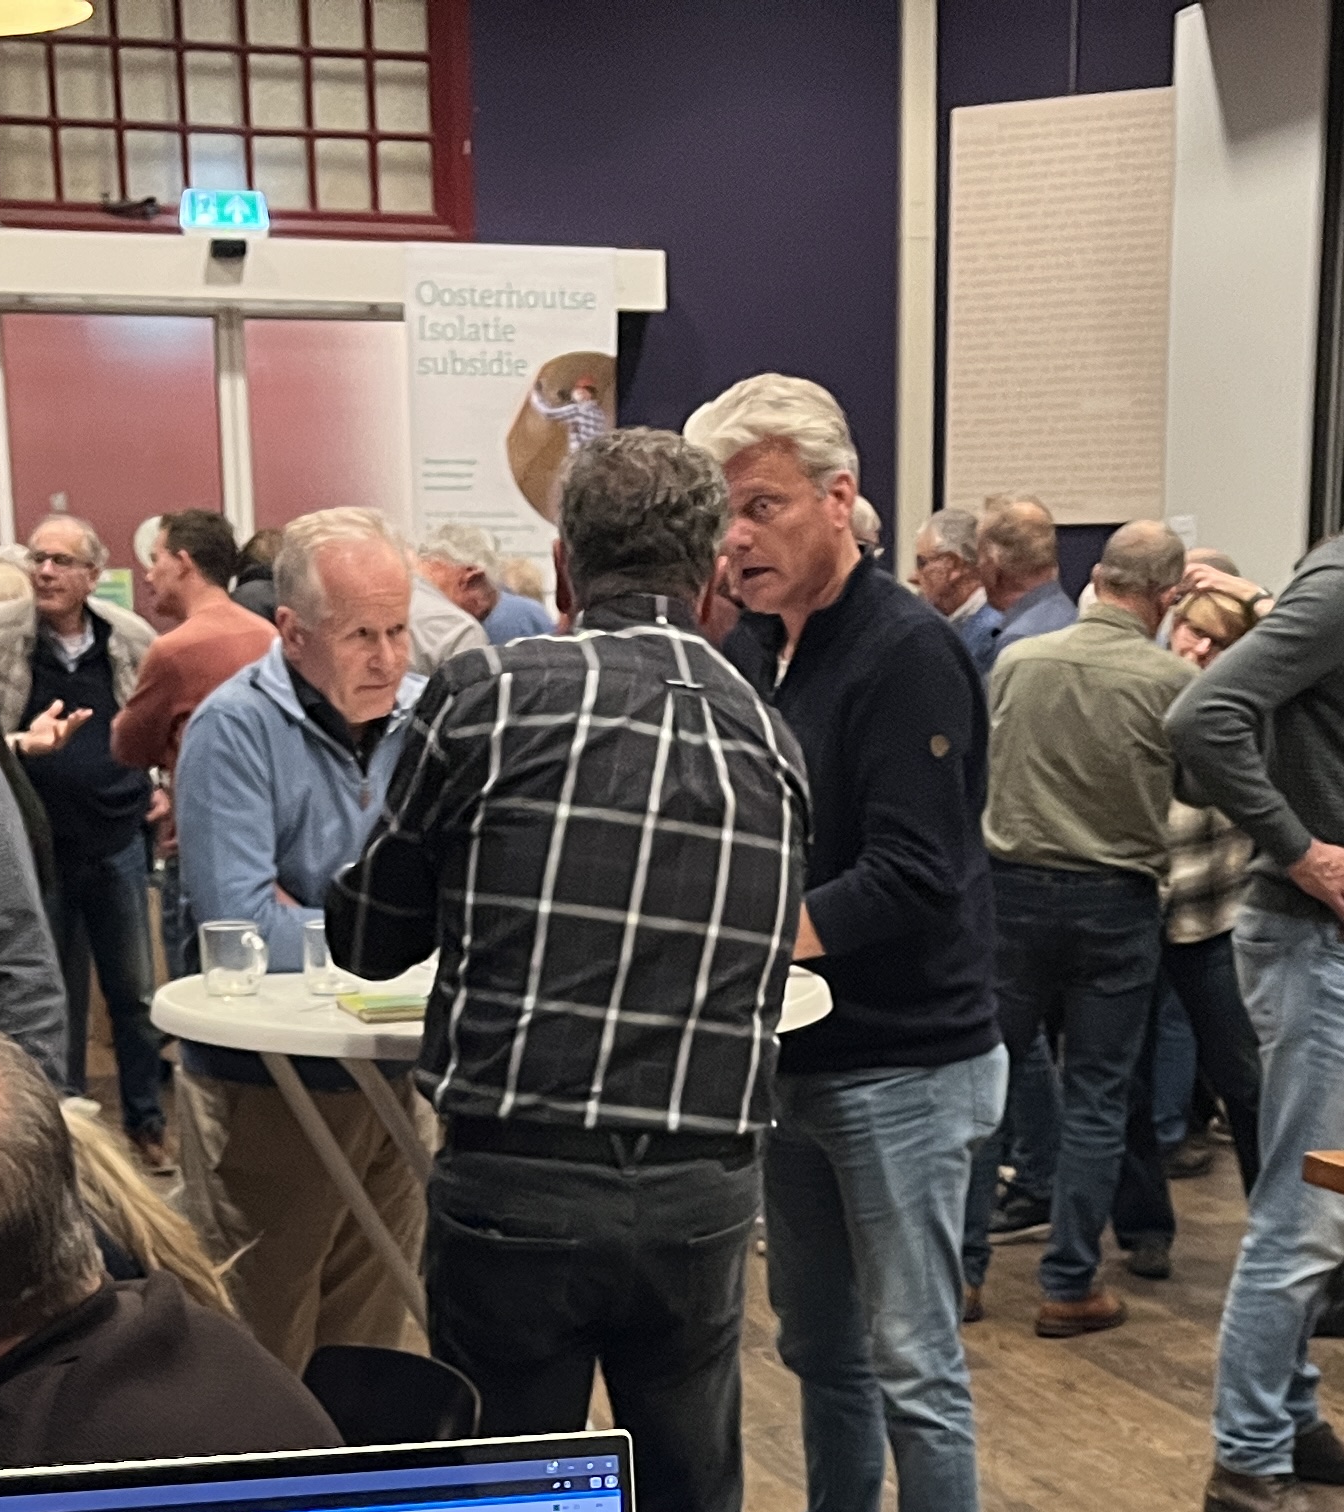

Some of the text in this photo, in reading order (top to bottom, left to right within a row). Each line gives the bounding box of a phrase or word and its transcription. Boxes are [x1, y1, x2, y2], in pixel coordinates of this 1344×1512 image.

[415, 280, 597, 310] Oosterhoutse
[418, 315, 515, 342] Isolatie
[416, 349, 528, 376] subsidie
